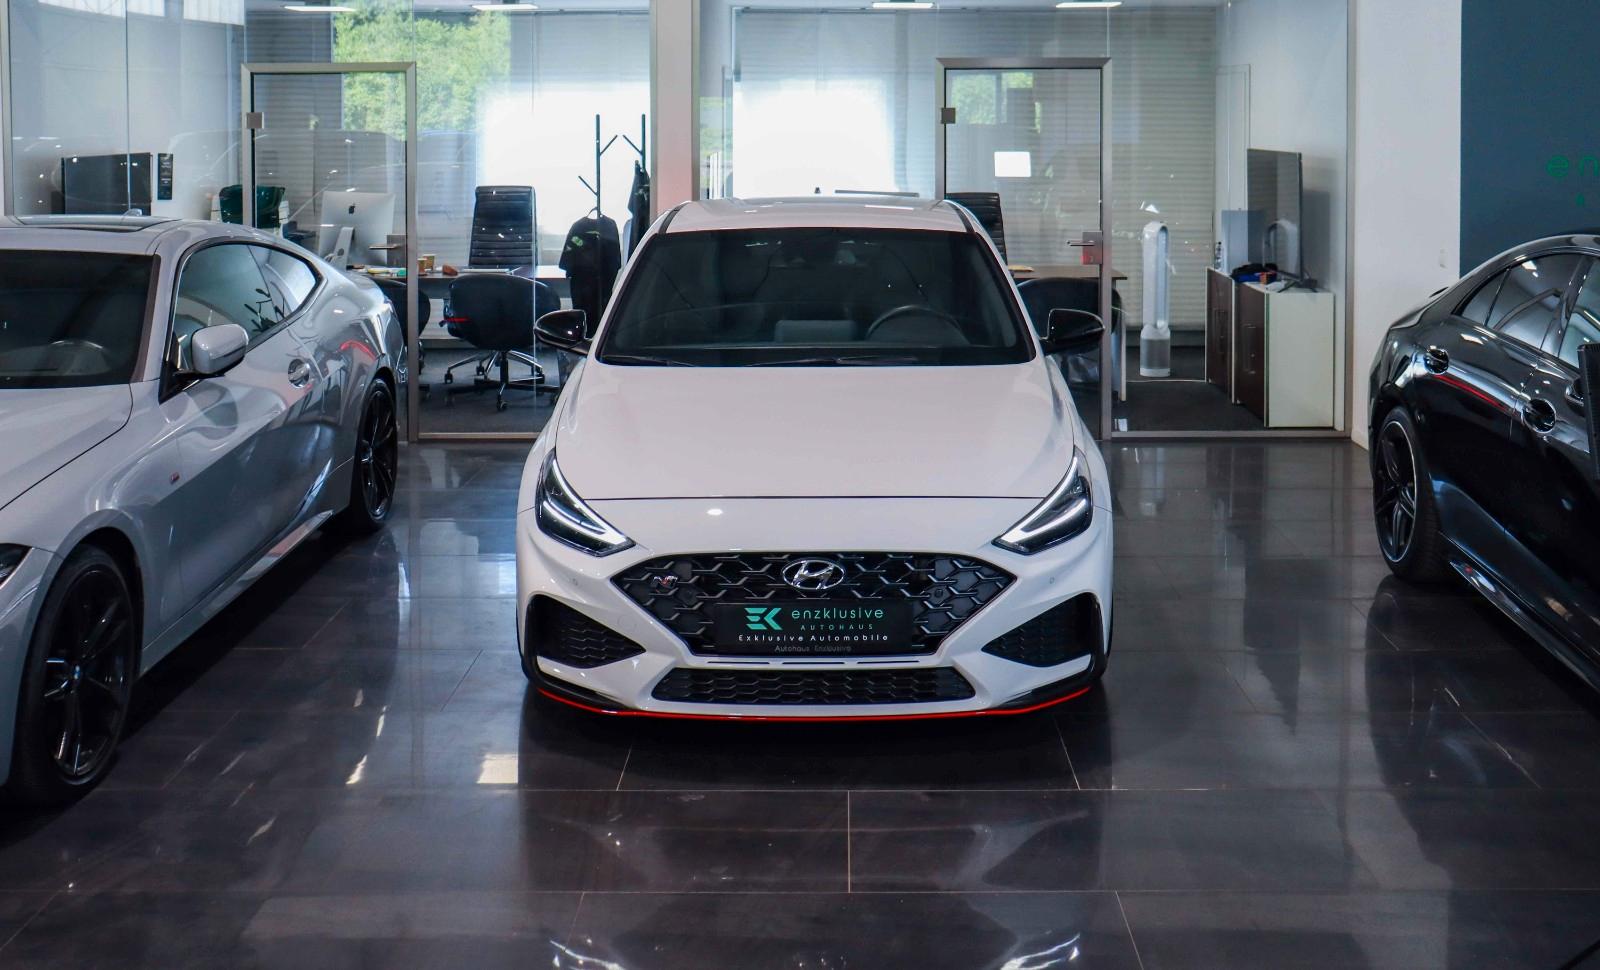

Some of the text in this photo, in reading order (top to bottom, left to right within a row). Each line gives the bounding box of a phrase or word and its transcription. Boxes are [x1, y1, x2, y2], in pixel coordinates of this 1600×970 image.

[791, 607, 884, 619] enzklusive
[738, 634, 888, 642] Exklusive Automobile
